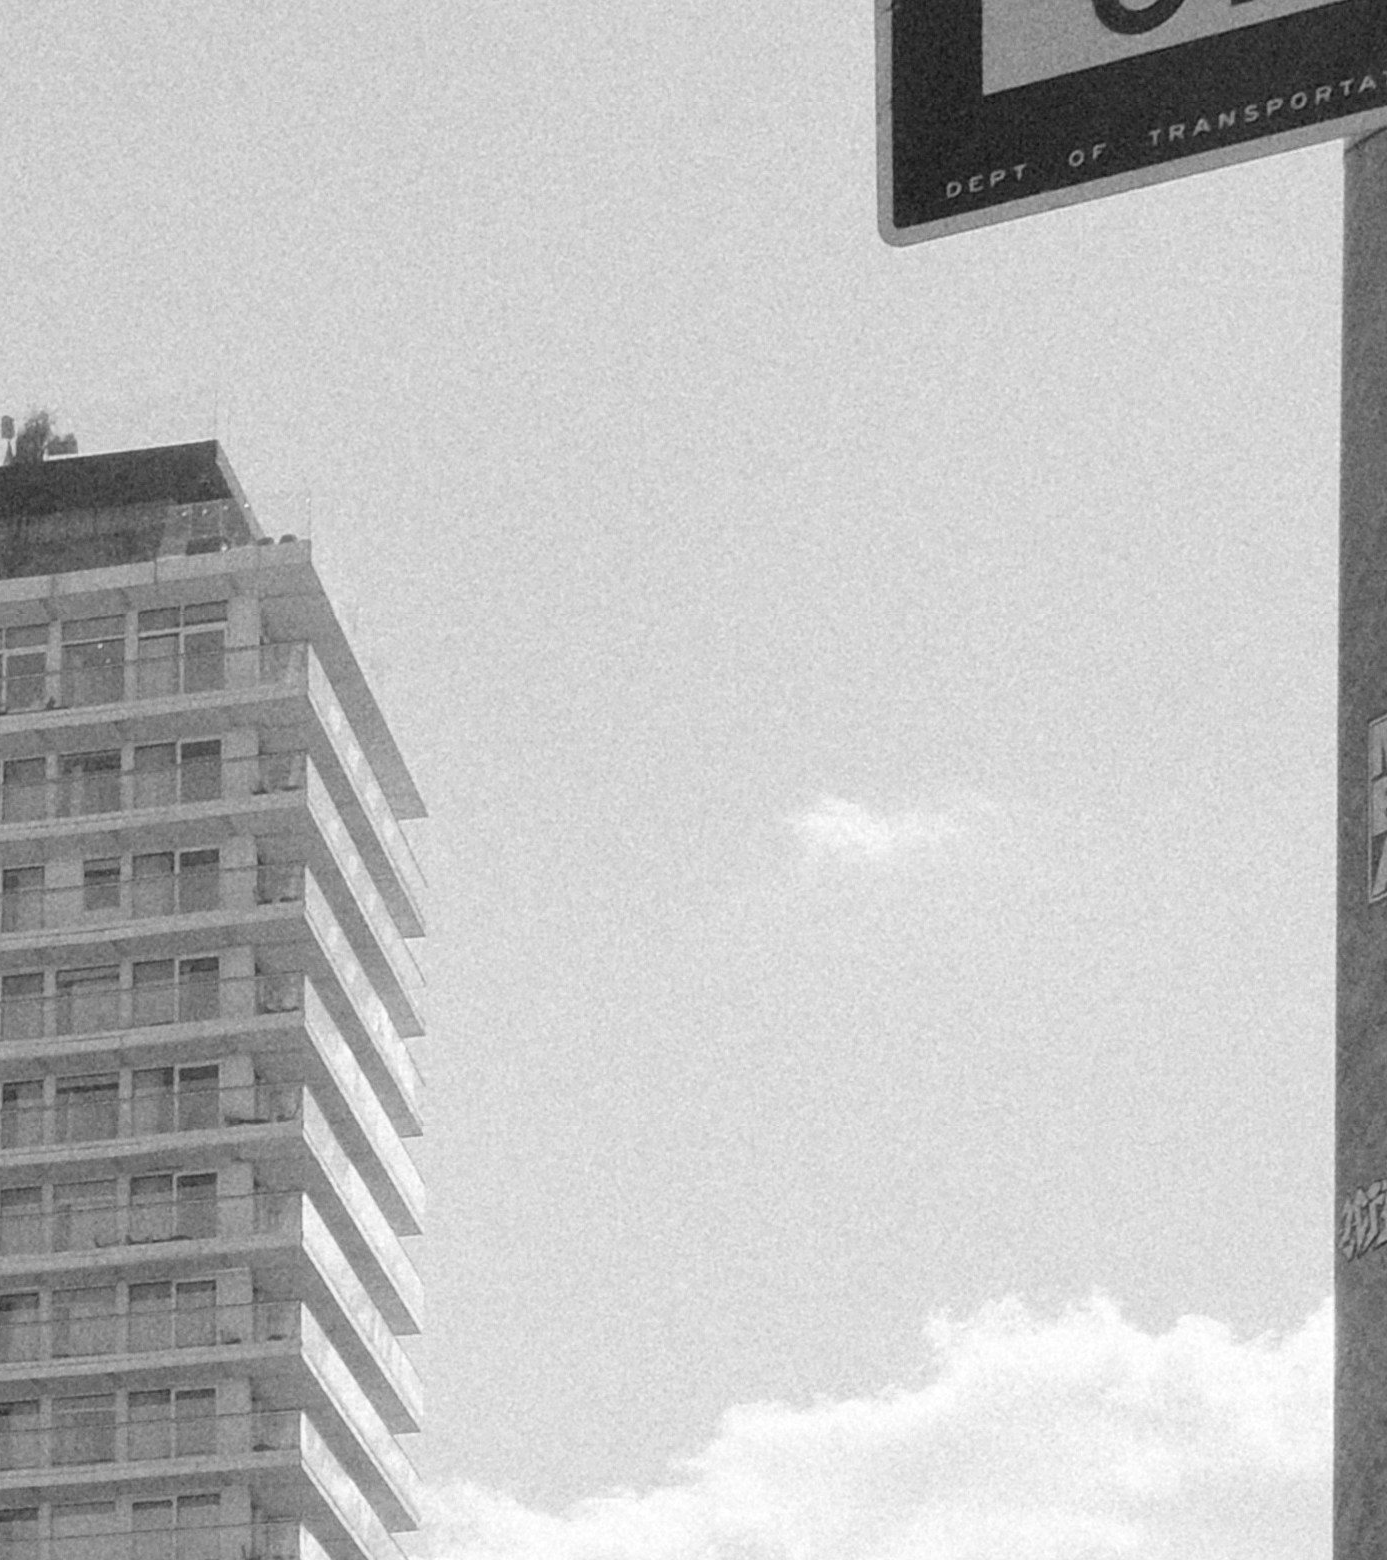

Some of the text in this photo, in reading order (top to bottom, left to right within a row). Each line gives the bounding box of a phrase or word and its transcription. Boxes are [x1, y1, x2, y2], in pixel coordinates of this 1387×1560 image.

[946, 70, 1387, 198] DEPT OF TRANSPORTA
